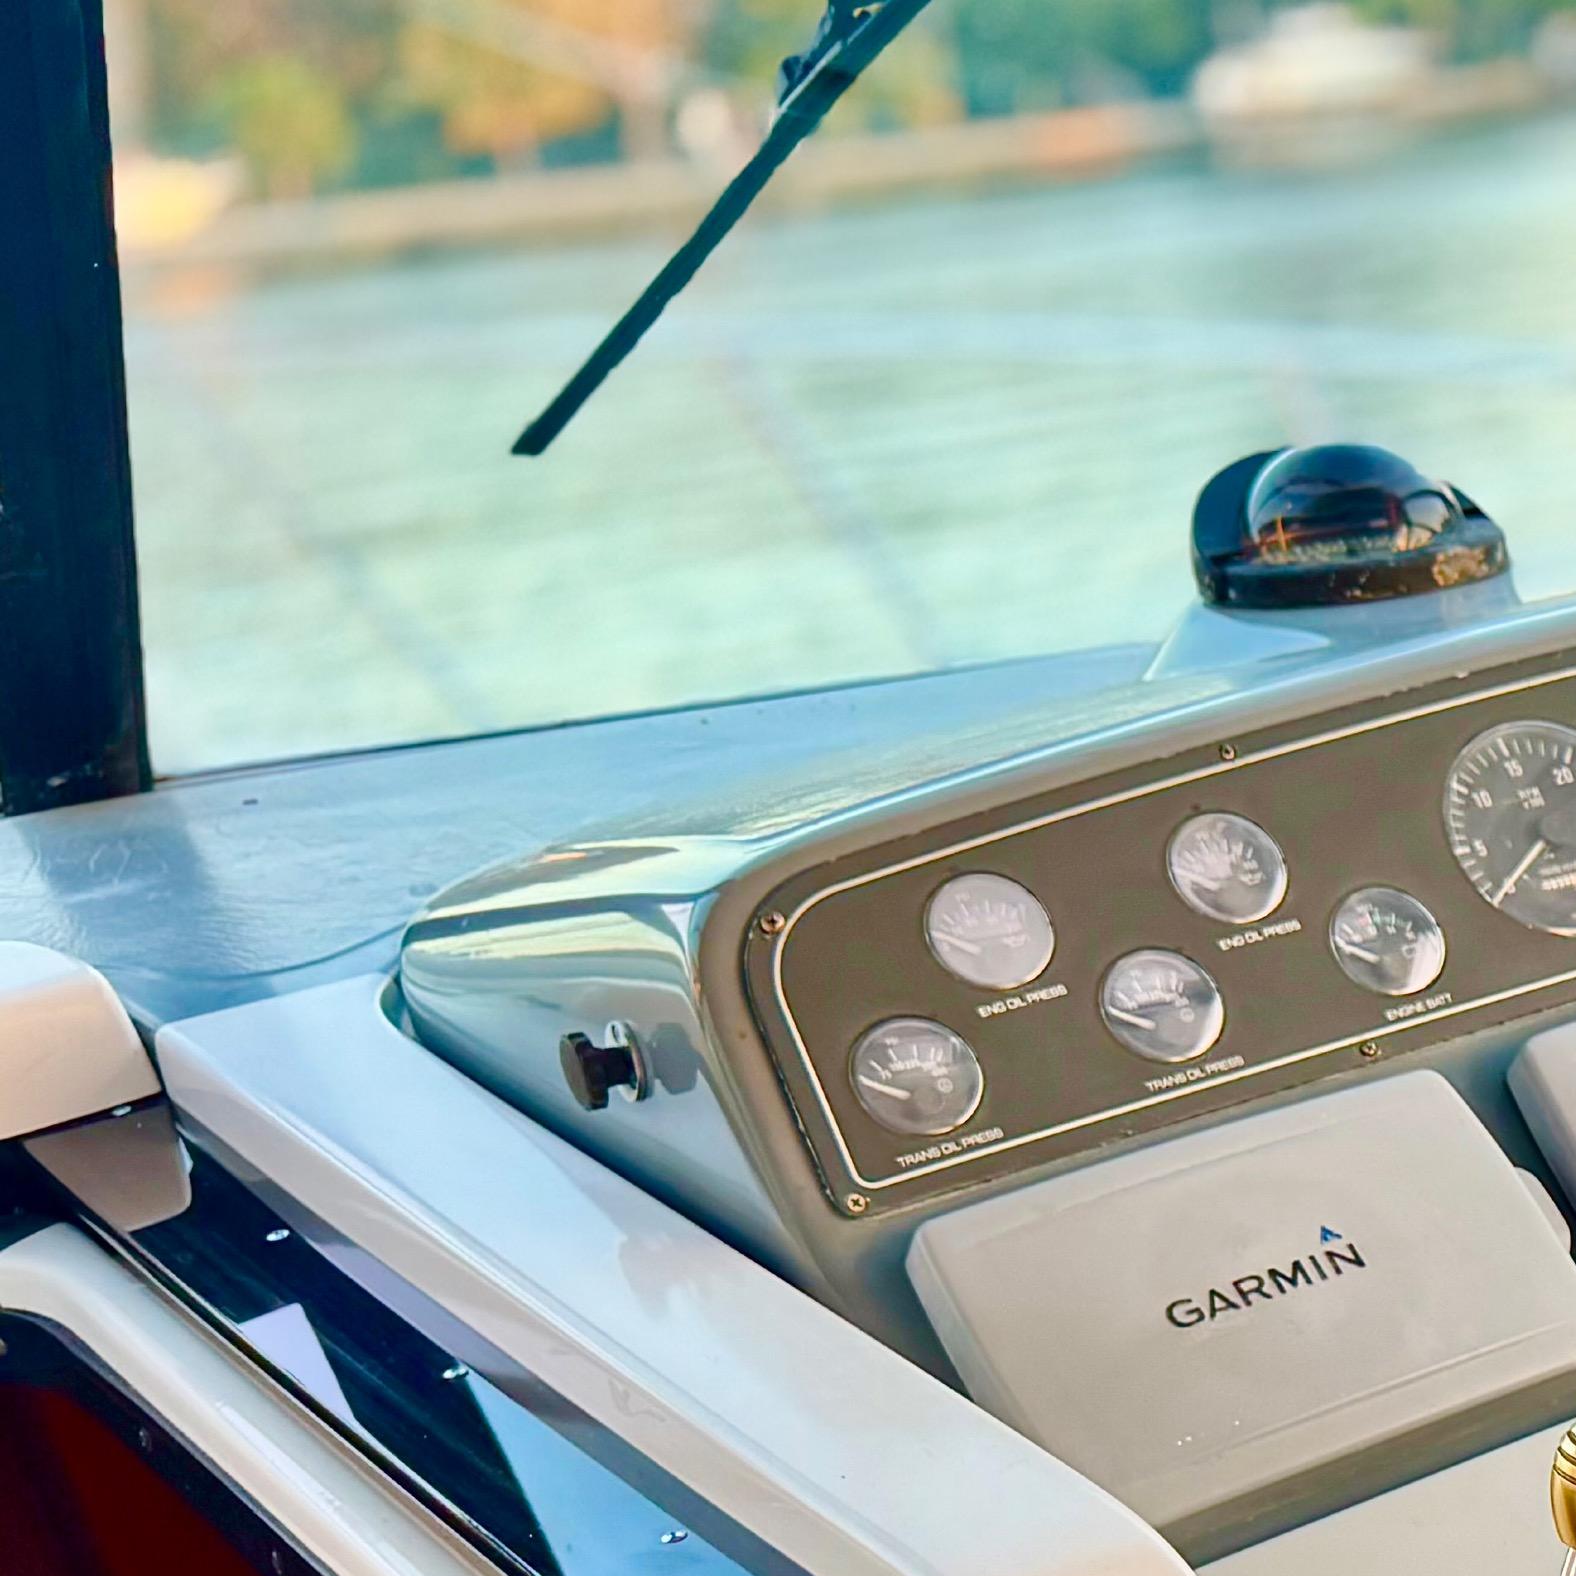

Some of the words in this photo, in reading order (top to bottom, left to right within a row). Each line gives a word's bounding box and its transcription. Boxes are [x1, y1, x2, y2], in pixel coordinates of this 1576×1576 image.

[1503, 758, 1524, 779] 15
[1552, 766, 1575, 786] 20
[1471, 789, 1492, 808] 10
[1472, 839, 1488, 857] 5
[1216, 934, 1244, 951] ENG
[1244, 930, 1262, 946] OIL
[1263, 918, 1302, 939] PRESS
[976, 1001, 1008, 1018] ENG
[1008, 996, 1027, 1013] OIL
[1027, 984, 1068, 1005] PRESS
[1384, 1002, 1426, 1022] ENGINE
[1426, 992, 1453, 1010] BATT
[1144, 1073, 1187, 1093] TRANS
[1188, 1066, 1206, 1082] OIL
[1206, 1055, 1245, 1075] PRESS
[896, 1146, 939, 1169] TRANS
[941, 1139, 961, 1155] OIL
[961, 1127, 1004, 1149] PRESS
[1165, 1243, 1366, 1329] GARMIN
